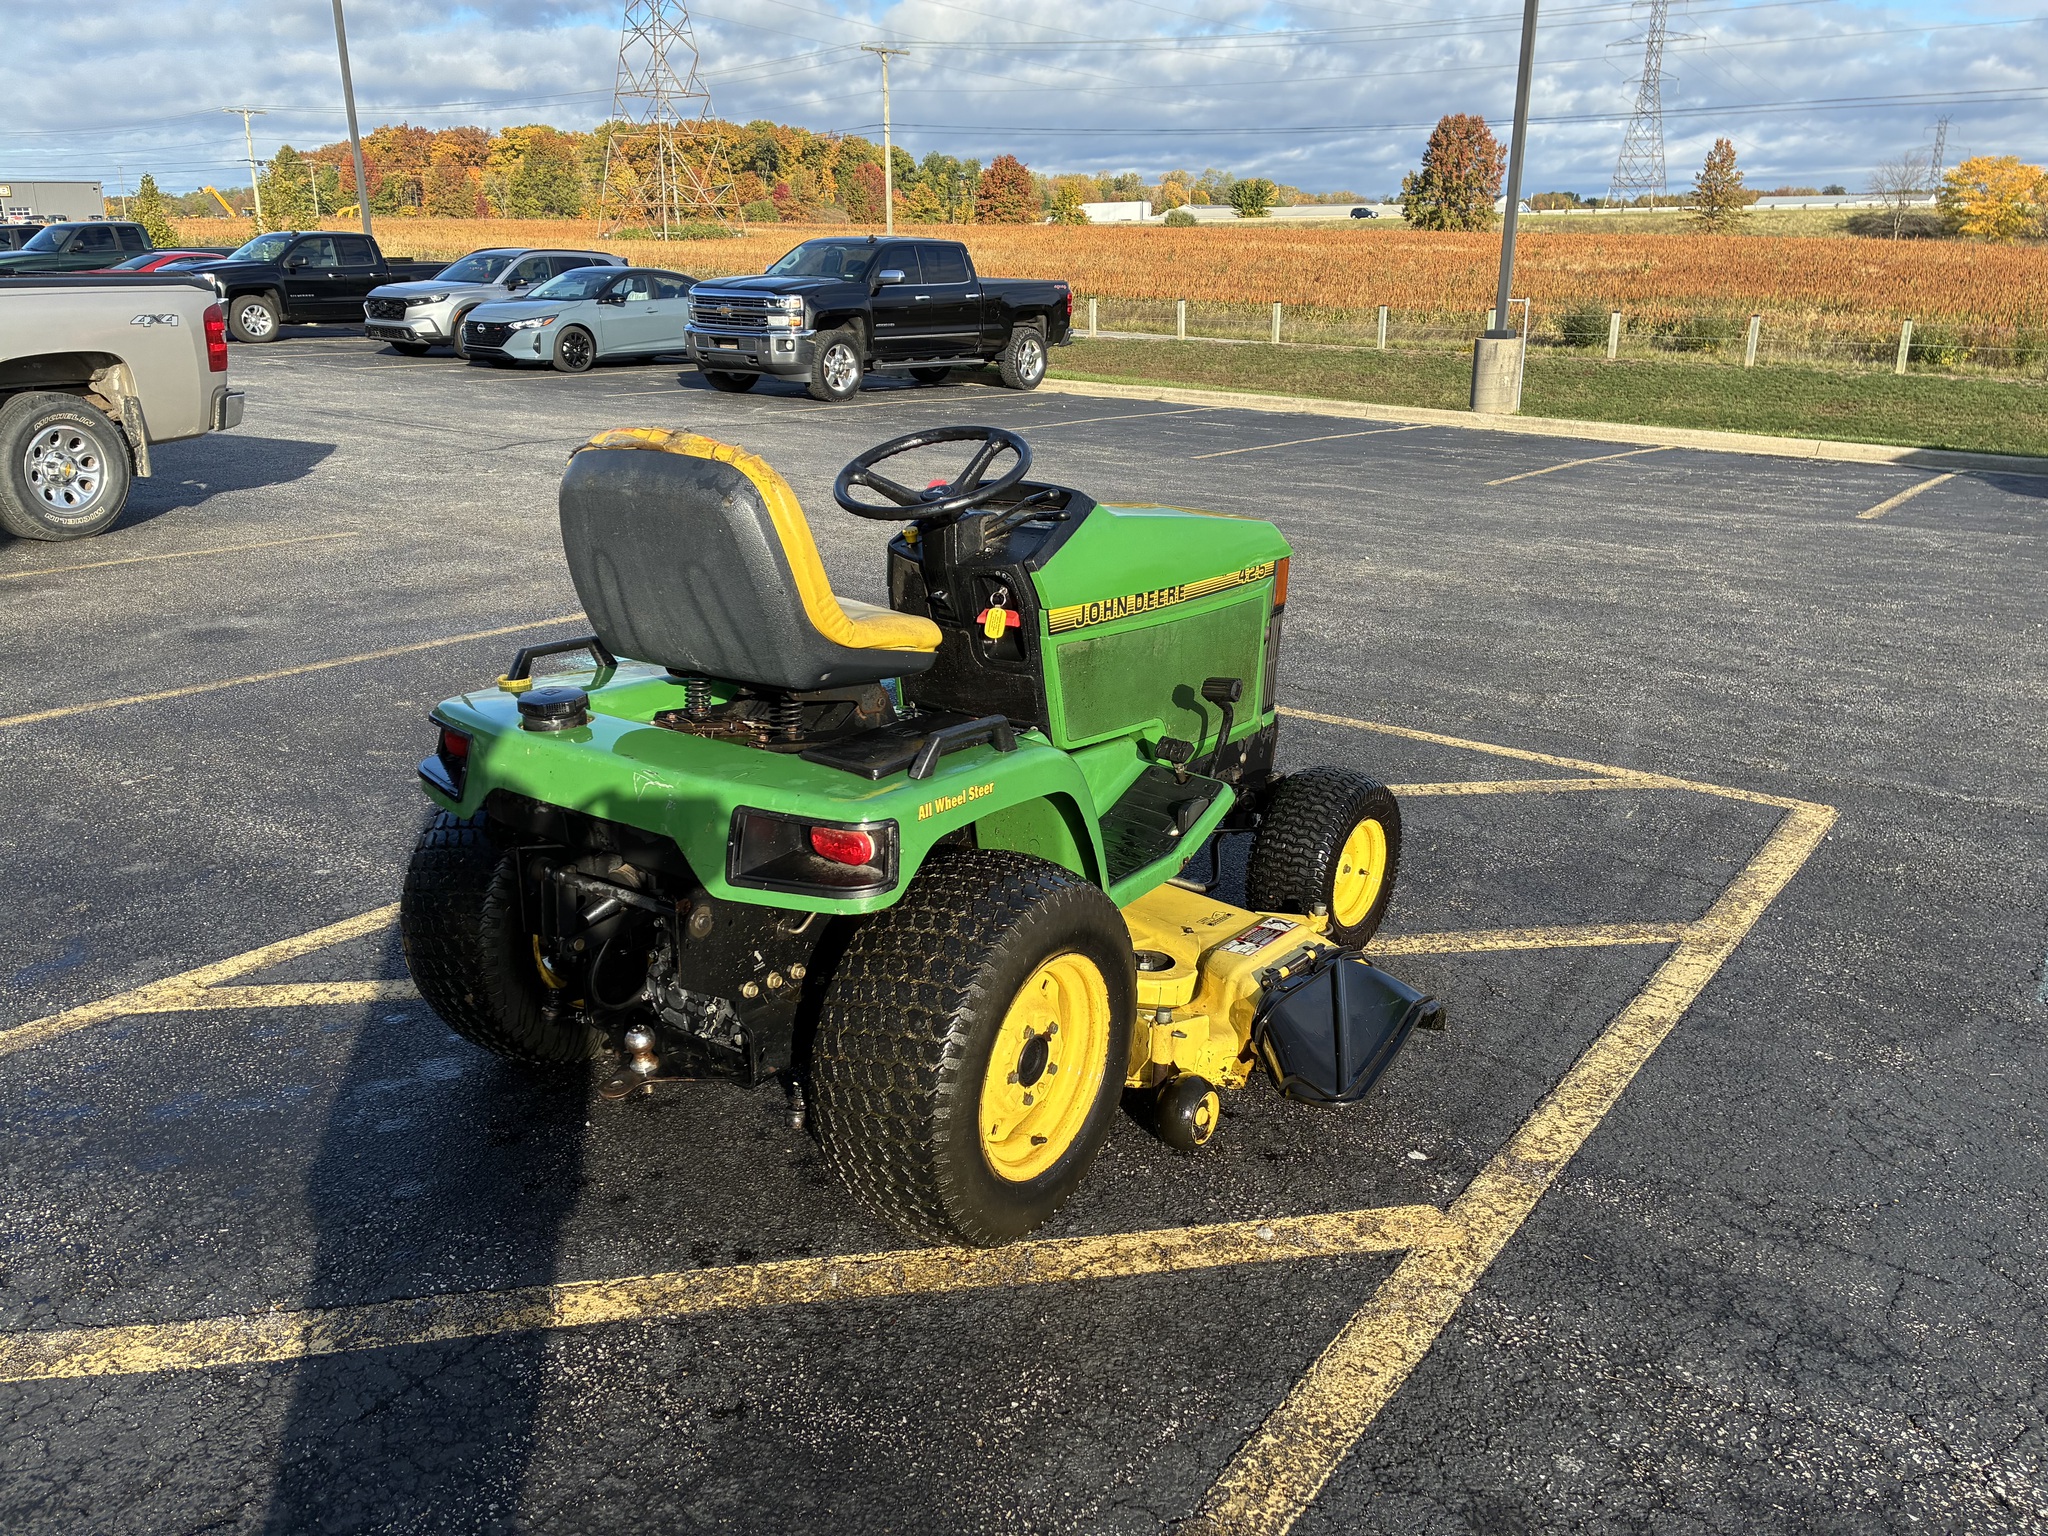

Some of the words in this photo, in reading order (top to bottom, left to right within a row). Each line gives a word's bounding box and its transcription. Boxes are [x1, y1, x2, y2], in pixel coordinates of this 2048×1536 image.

[34, 413, 95, 430] MICHELIN
[44, 505, 106, 526] MICHELIN
[1237, 564, 1267, 585] 425
[1074, 596, 1129, 627] JOHN
[1134, 584, 1187, 613] DEERE
[917, 802, 932, 821] All
[934, 789, 967, 814] Wheel
[968, 781, 995, 801] Steer
